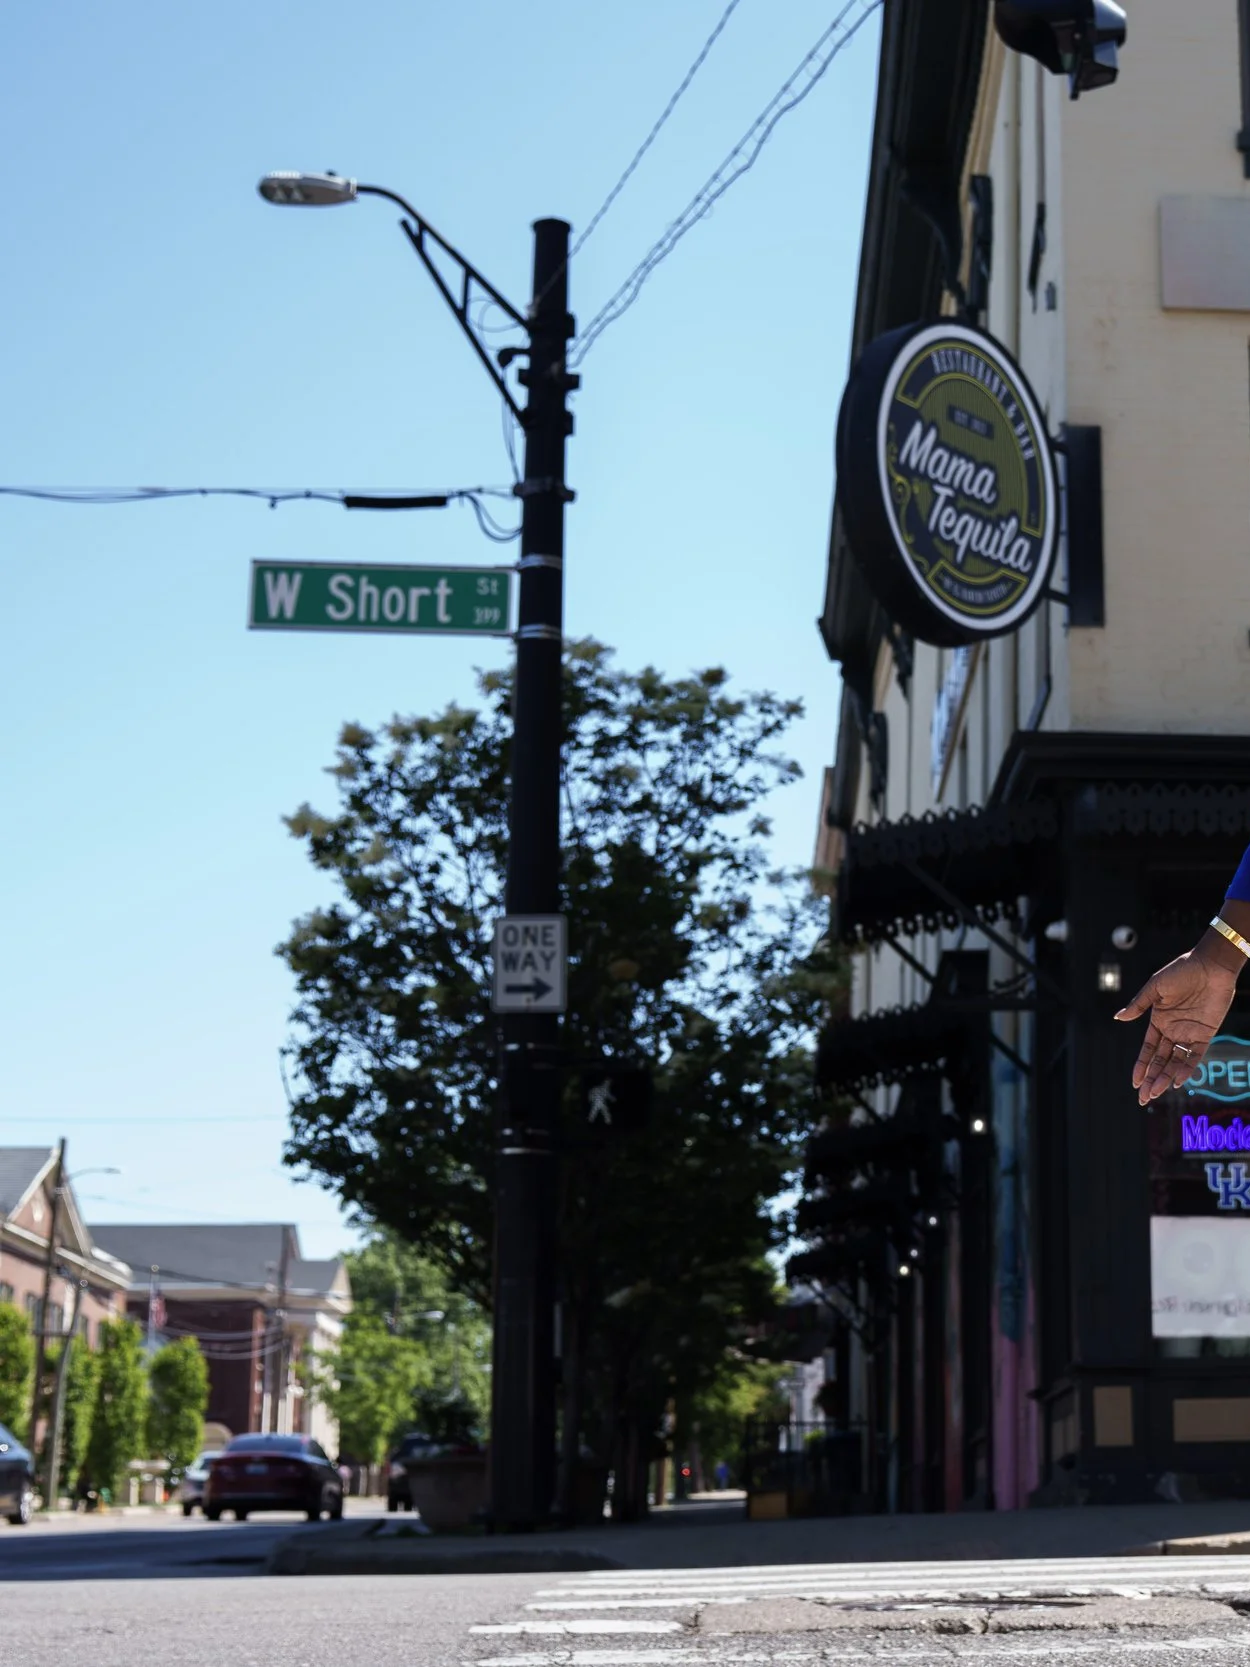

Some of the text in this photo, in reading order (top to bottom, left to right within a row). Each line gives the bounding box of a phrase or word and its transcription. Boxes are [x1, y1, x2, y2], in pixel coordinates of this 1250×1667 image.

[900, 420, 997, 503] Mama
[928, 484, 1032, 572] Tequila
[263, 571, 499, 623] W Short St
[473, 606, 501, 625] 399
[502, 925, 556, 948] ONE
[501, 951, 557, 973] WAY
